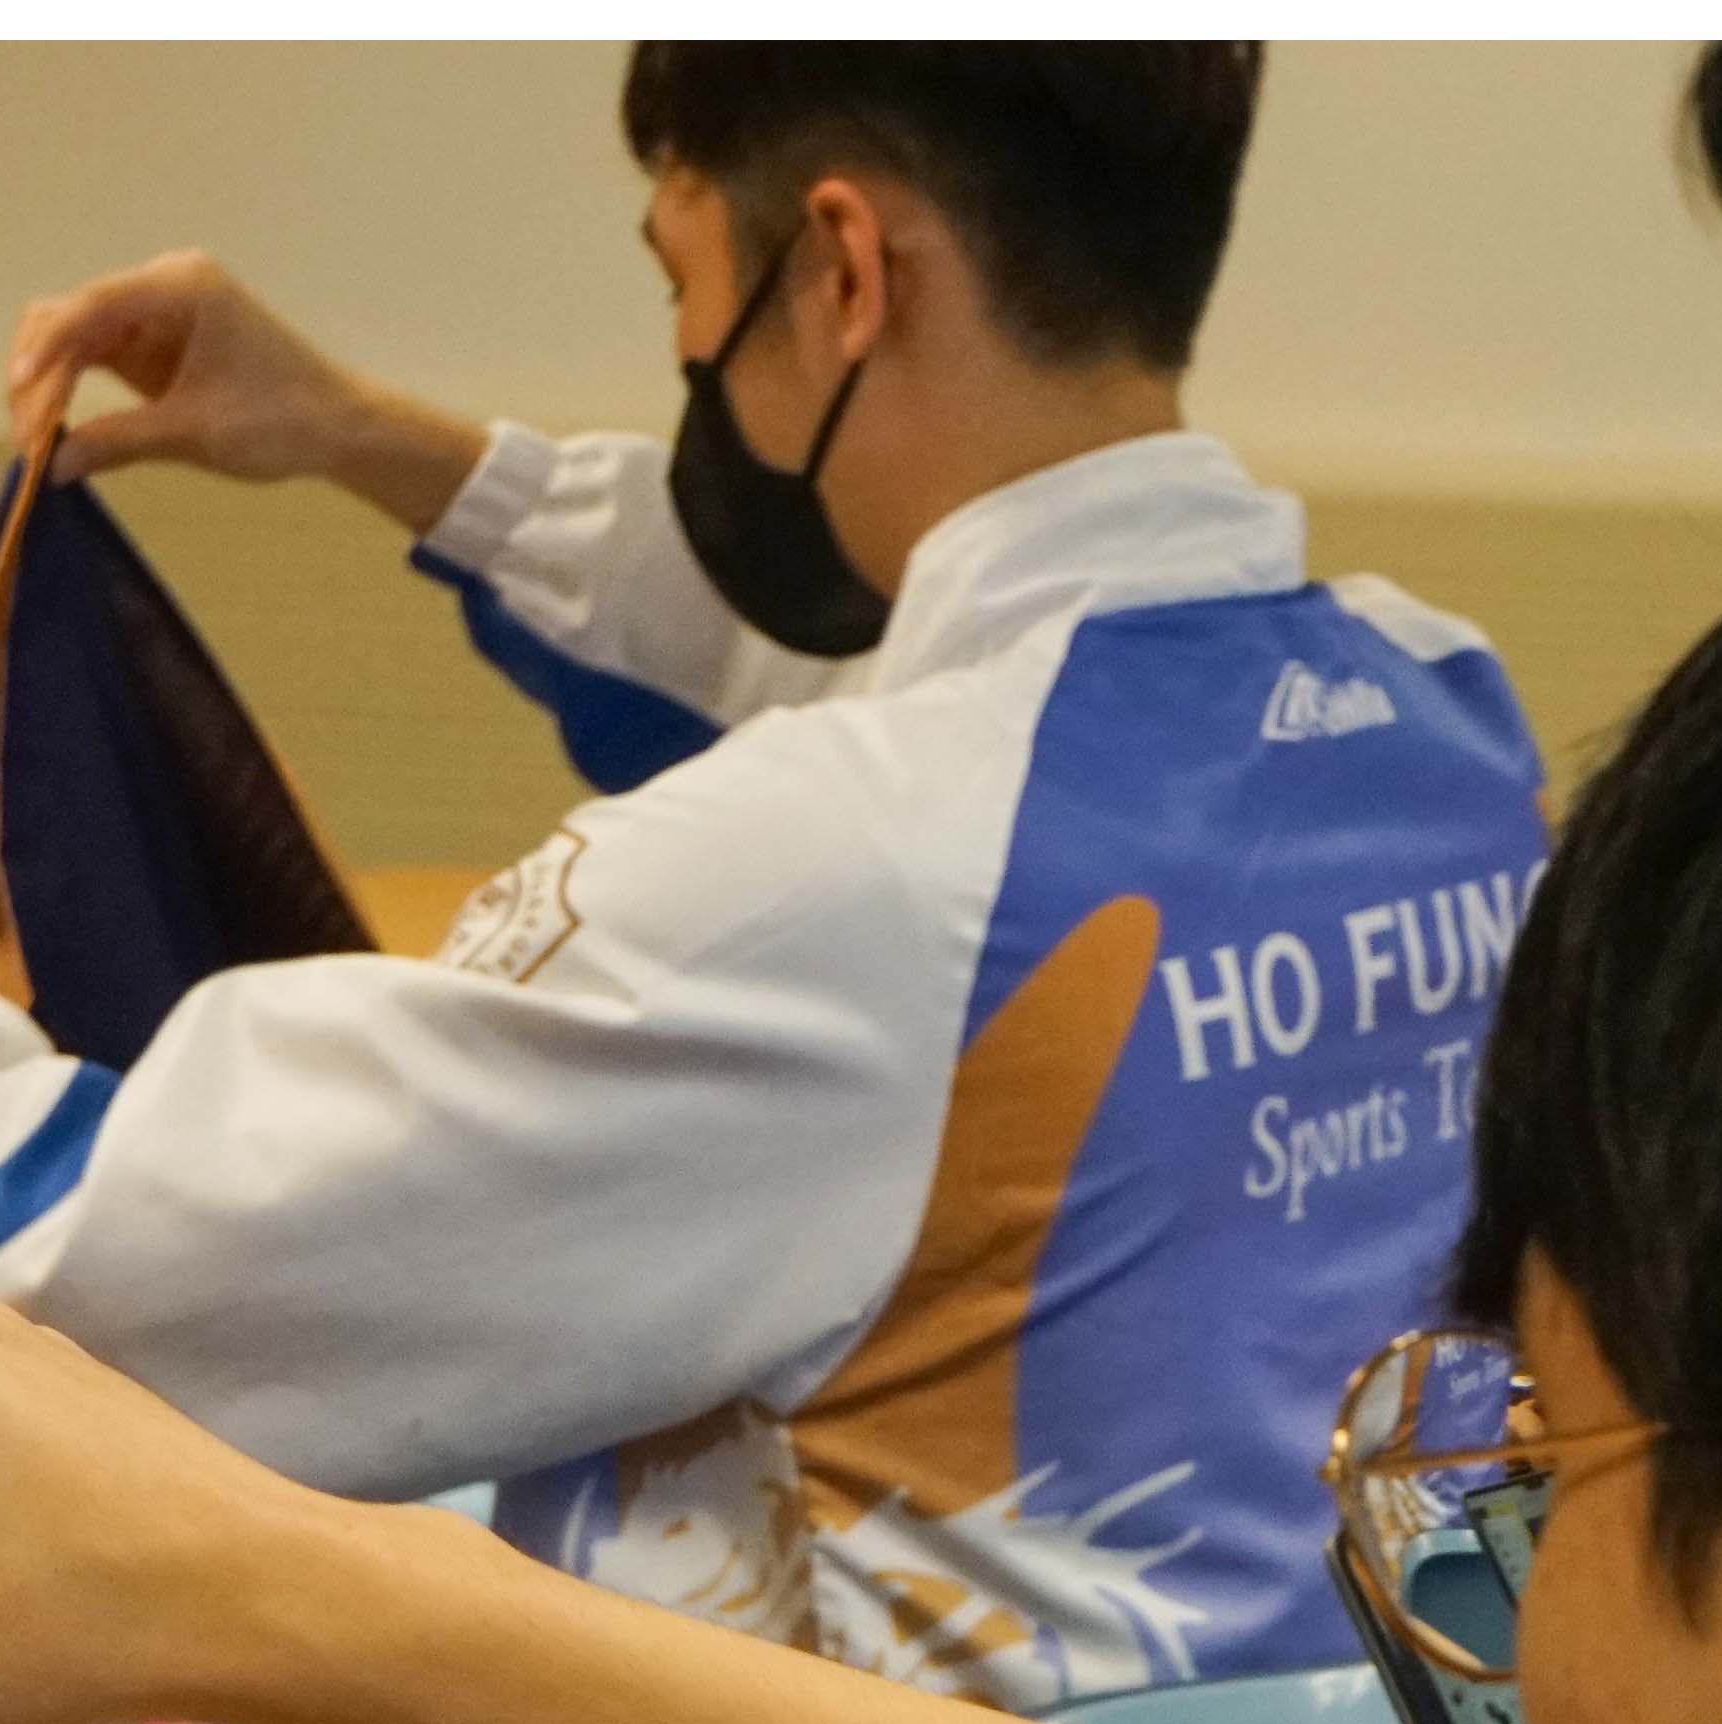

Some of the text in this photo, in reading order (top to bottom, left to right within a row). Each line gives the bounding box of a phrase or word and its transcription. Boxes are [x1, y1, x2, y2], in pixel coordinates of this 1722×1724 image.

[1159, 858, 1548, 1082] HO FUN
[1243, 1038, 1478, 1222] Sports T
